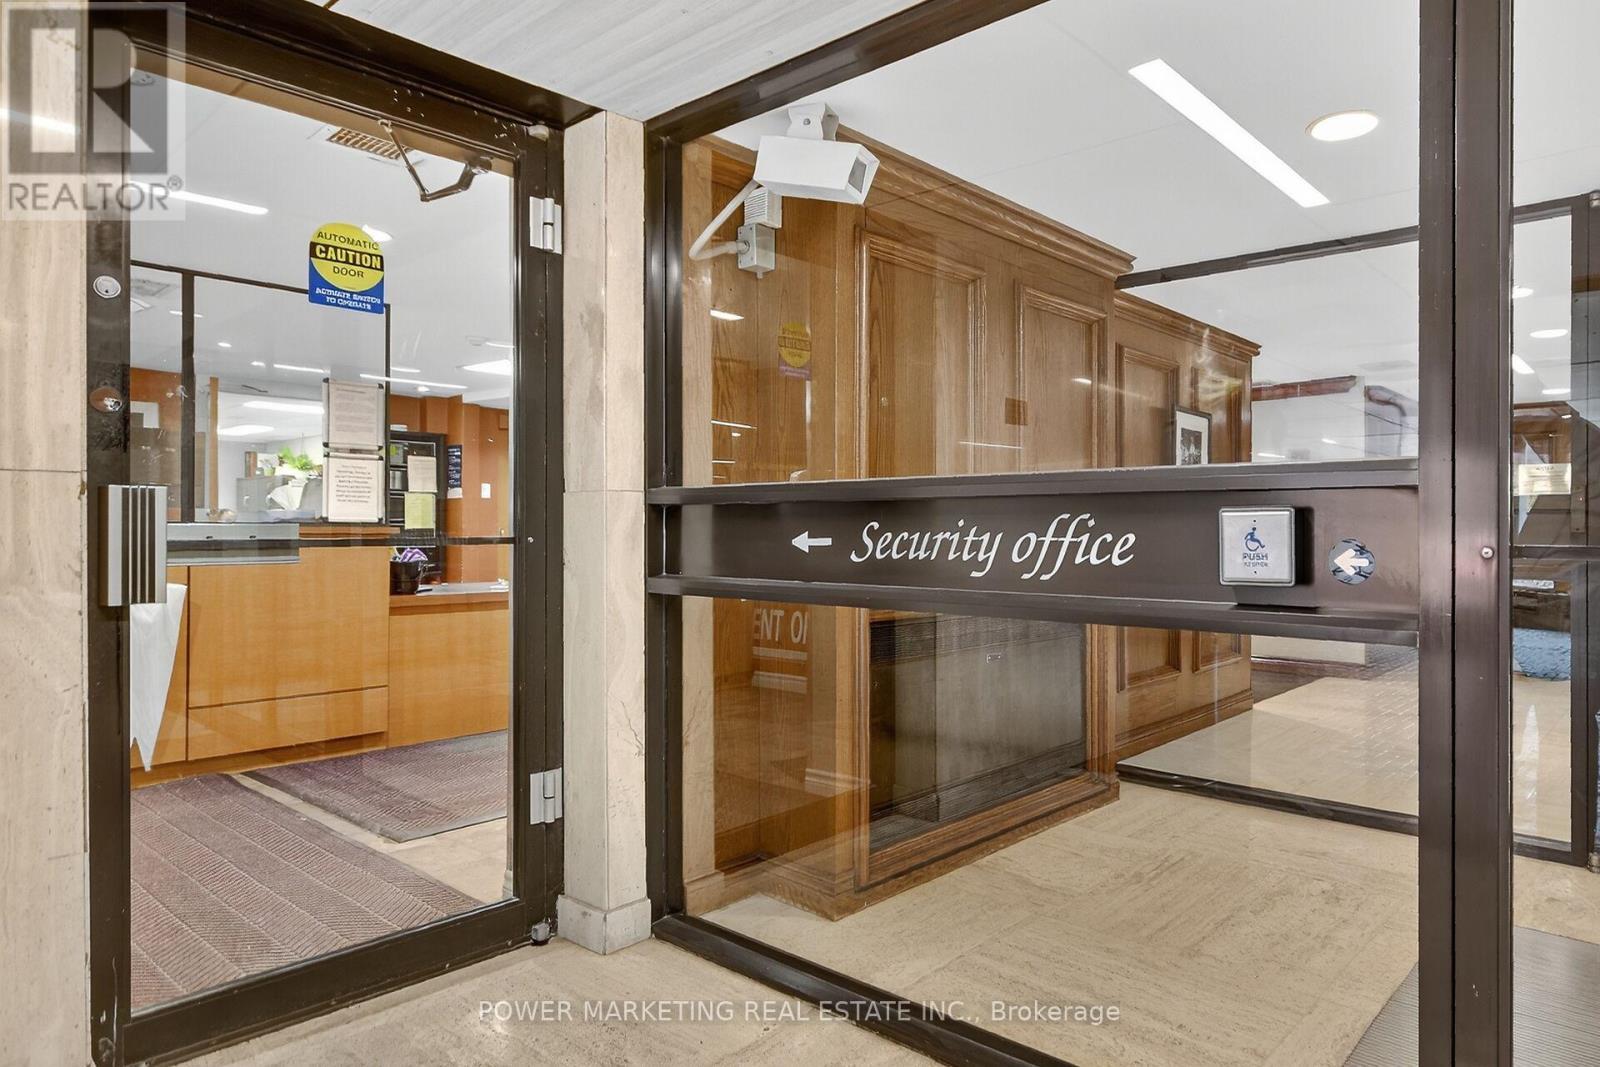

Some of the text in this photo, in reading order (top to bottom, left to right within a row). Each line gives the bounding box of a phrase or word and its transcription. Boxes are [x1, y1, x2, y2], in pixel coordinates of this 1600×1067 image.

[316, 231, 379, 251] AUTOMATIC
[315, 244, 381, 269] CAUTION
[332, 265, 364, 278] DOOR
[326, 296, 336, 304] TO
[850, 513, 1136, 581] Security office
[1242, 552, 1269, 561] PUSH
